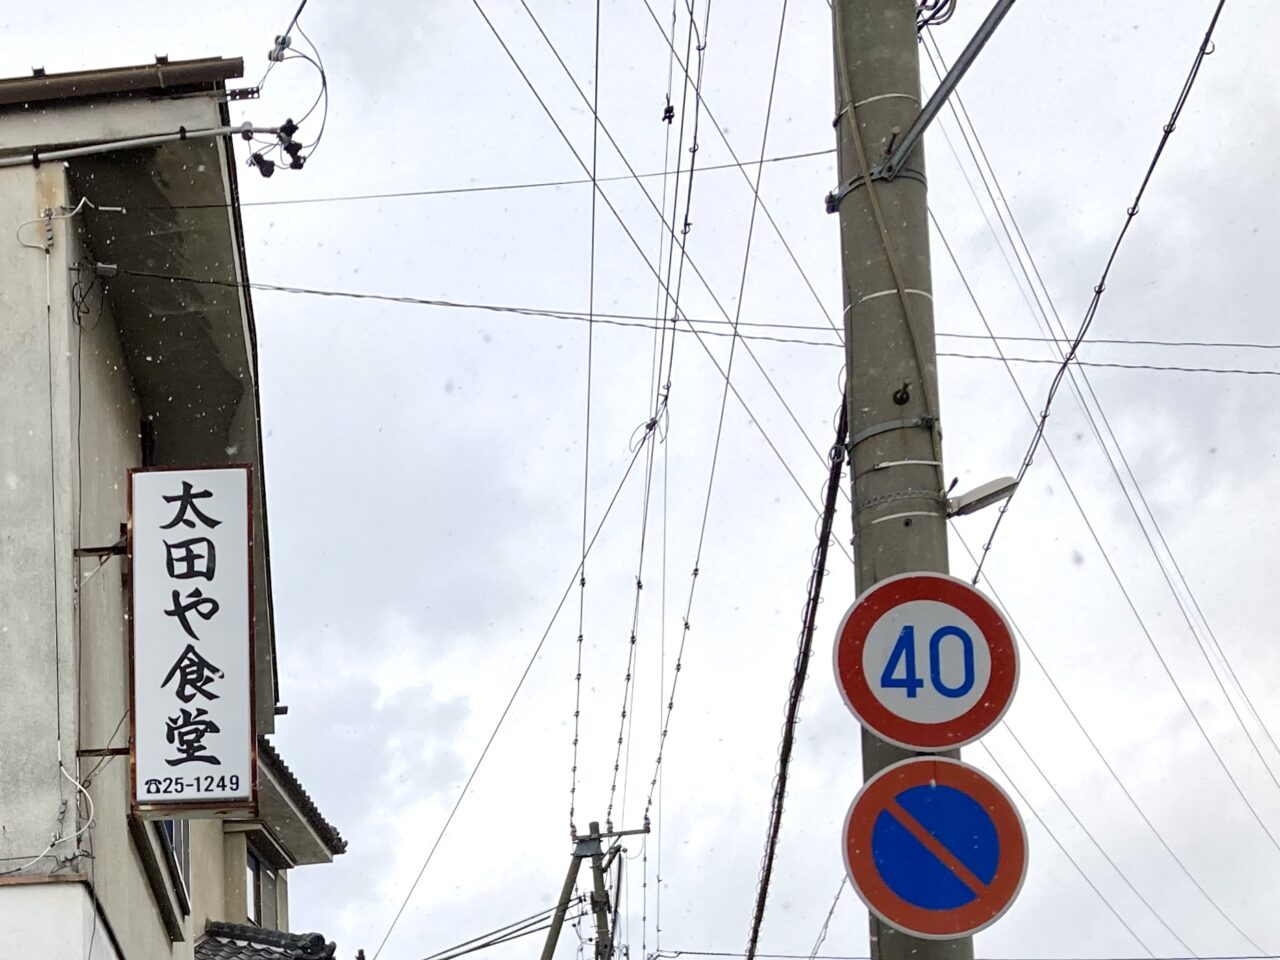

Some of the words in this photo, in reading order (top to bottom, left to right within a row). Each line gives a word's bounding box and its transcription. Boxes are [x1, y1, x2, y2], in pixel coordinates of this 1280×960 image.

[159, 481, 224, 766] 太田や食堂
[881, 625, 975, 698] 40
[162, 775, 240, 794] 25-1249
